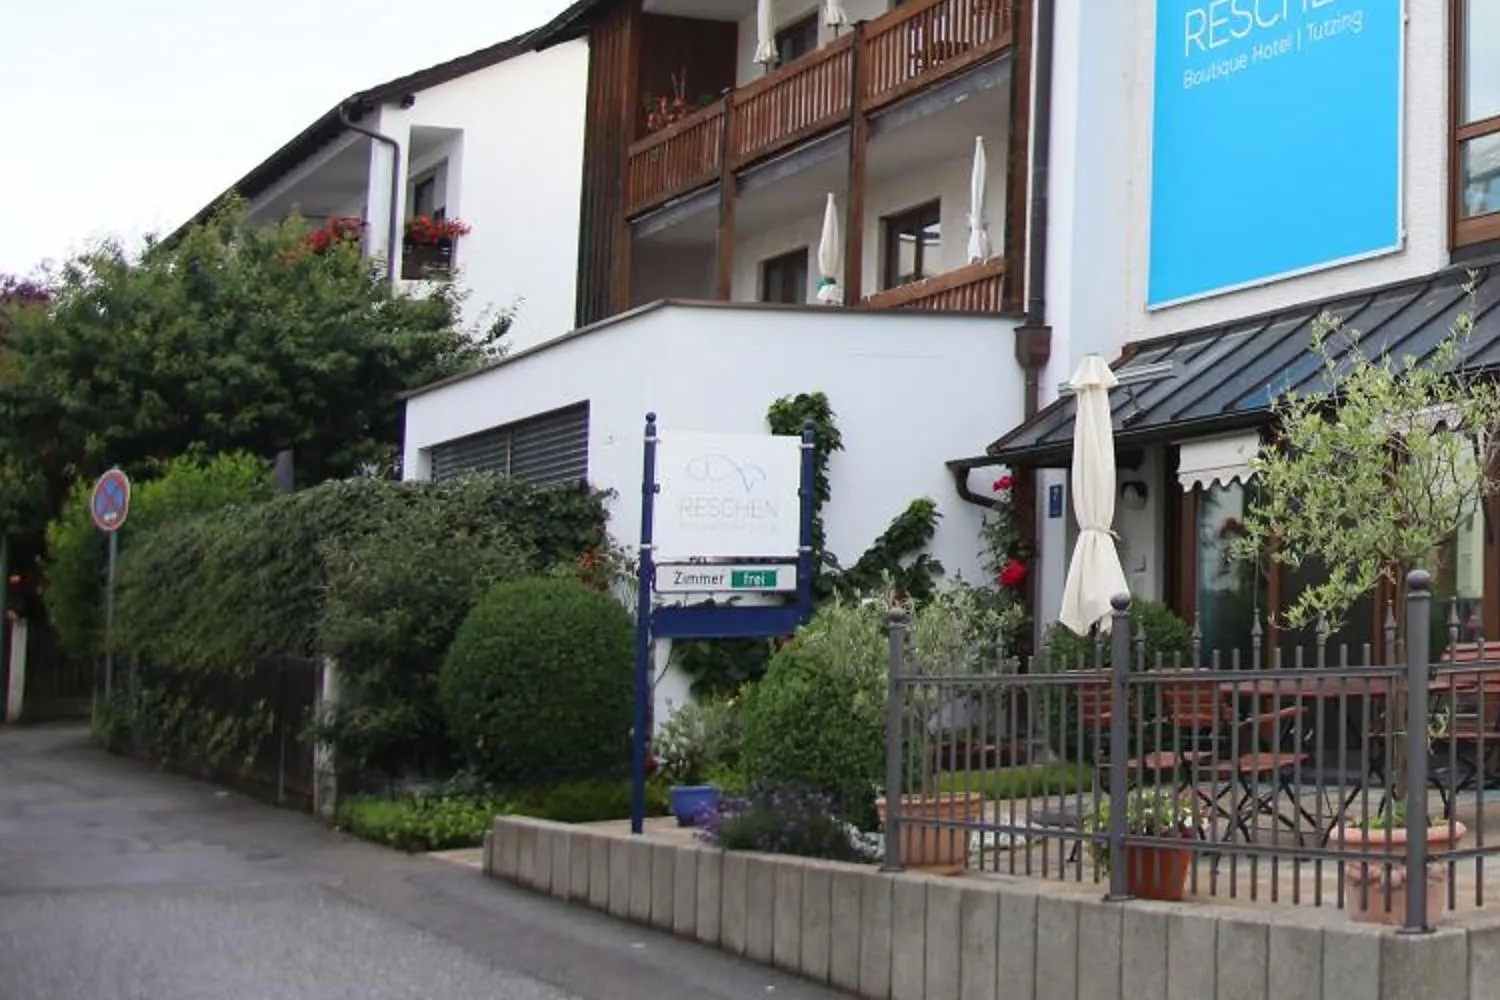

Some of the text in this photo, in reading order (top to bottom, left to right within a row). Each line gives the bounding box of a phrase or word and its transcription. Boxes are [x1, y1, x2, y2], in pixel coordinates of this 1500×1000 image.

[1183, 55, 1249, 89] Boutique
[1252, 34, 1293, 62] Hotel
[1306, 10, 1364, 41] Tutzing
[679, 497, 778, 519] RESCHEN
[673, 570, 766, 586] Zimmer frei
